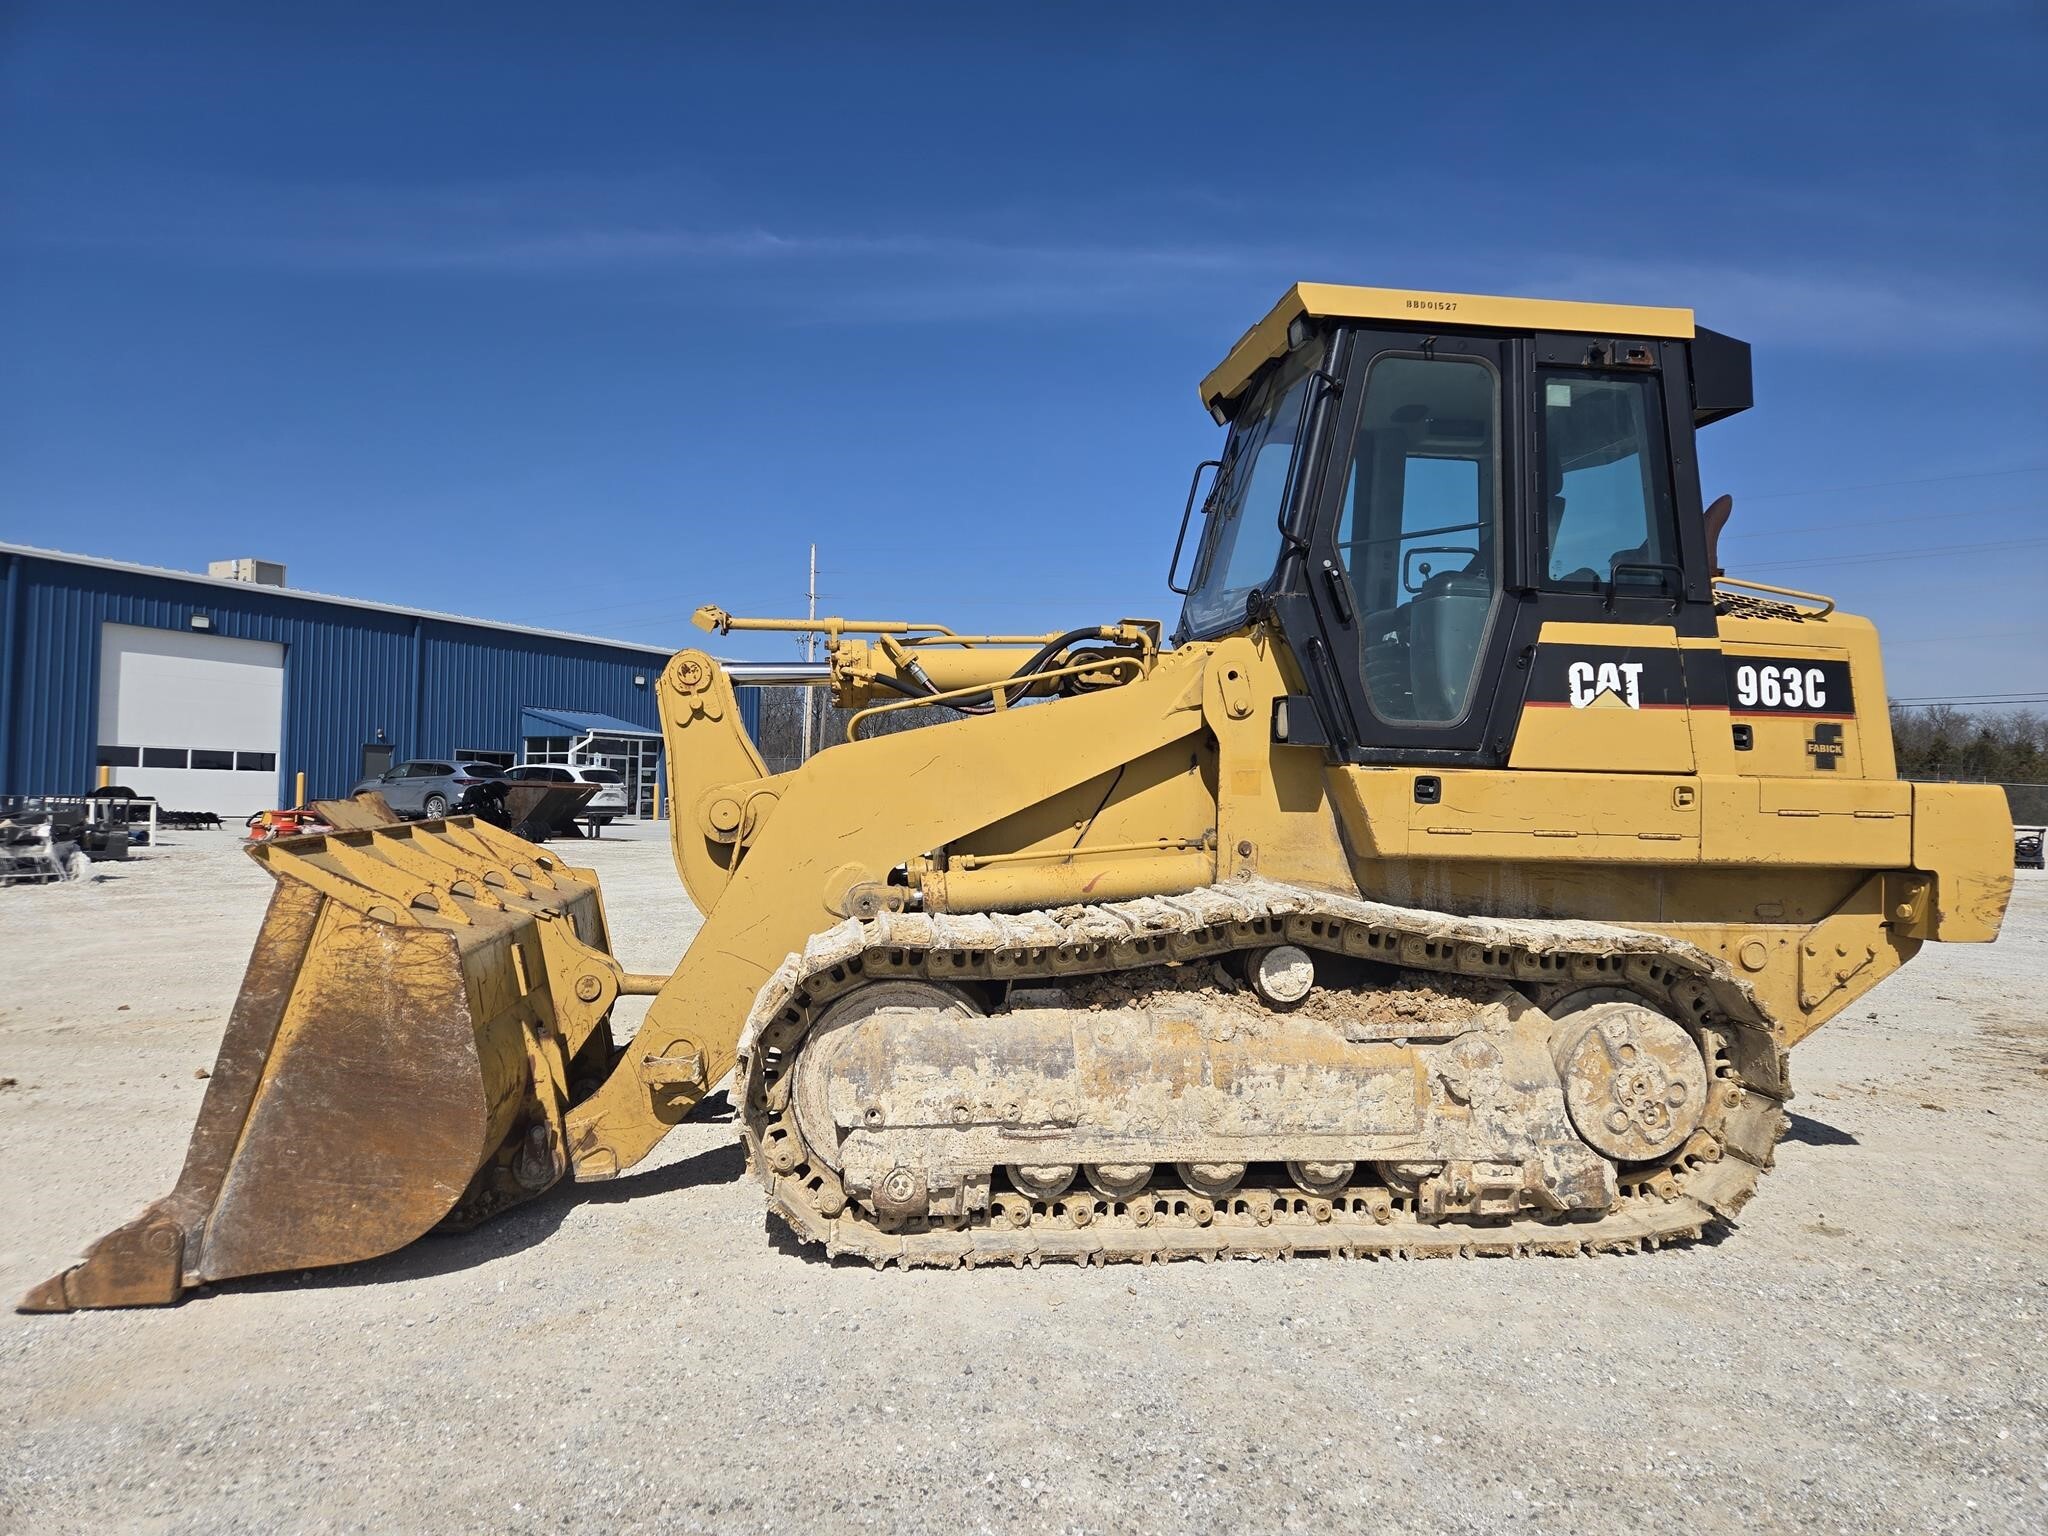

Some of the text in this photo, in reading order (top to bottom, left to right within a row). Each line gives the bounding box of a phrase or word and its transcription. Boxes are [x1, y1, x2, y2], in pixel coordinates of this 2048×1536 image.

[1406, 299, 1457, 311] BBD01527
[1568, 661, 1643, 710] CAT
[1737, 665, 1826, 709] 963C
[1808, 743, 1842, 754] FABICK
